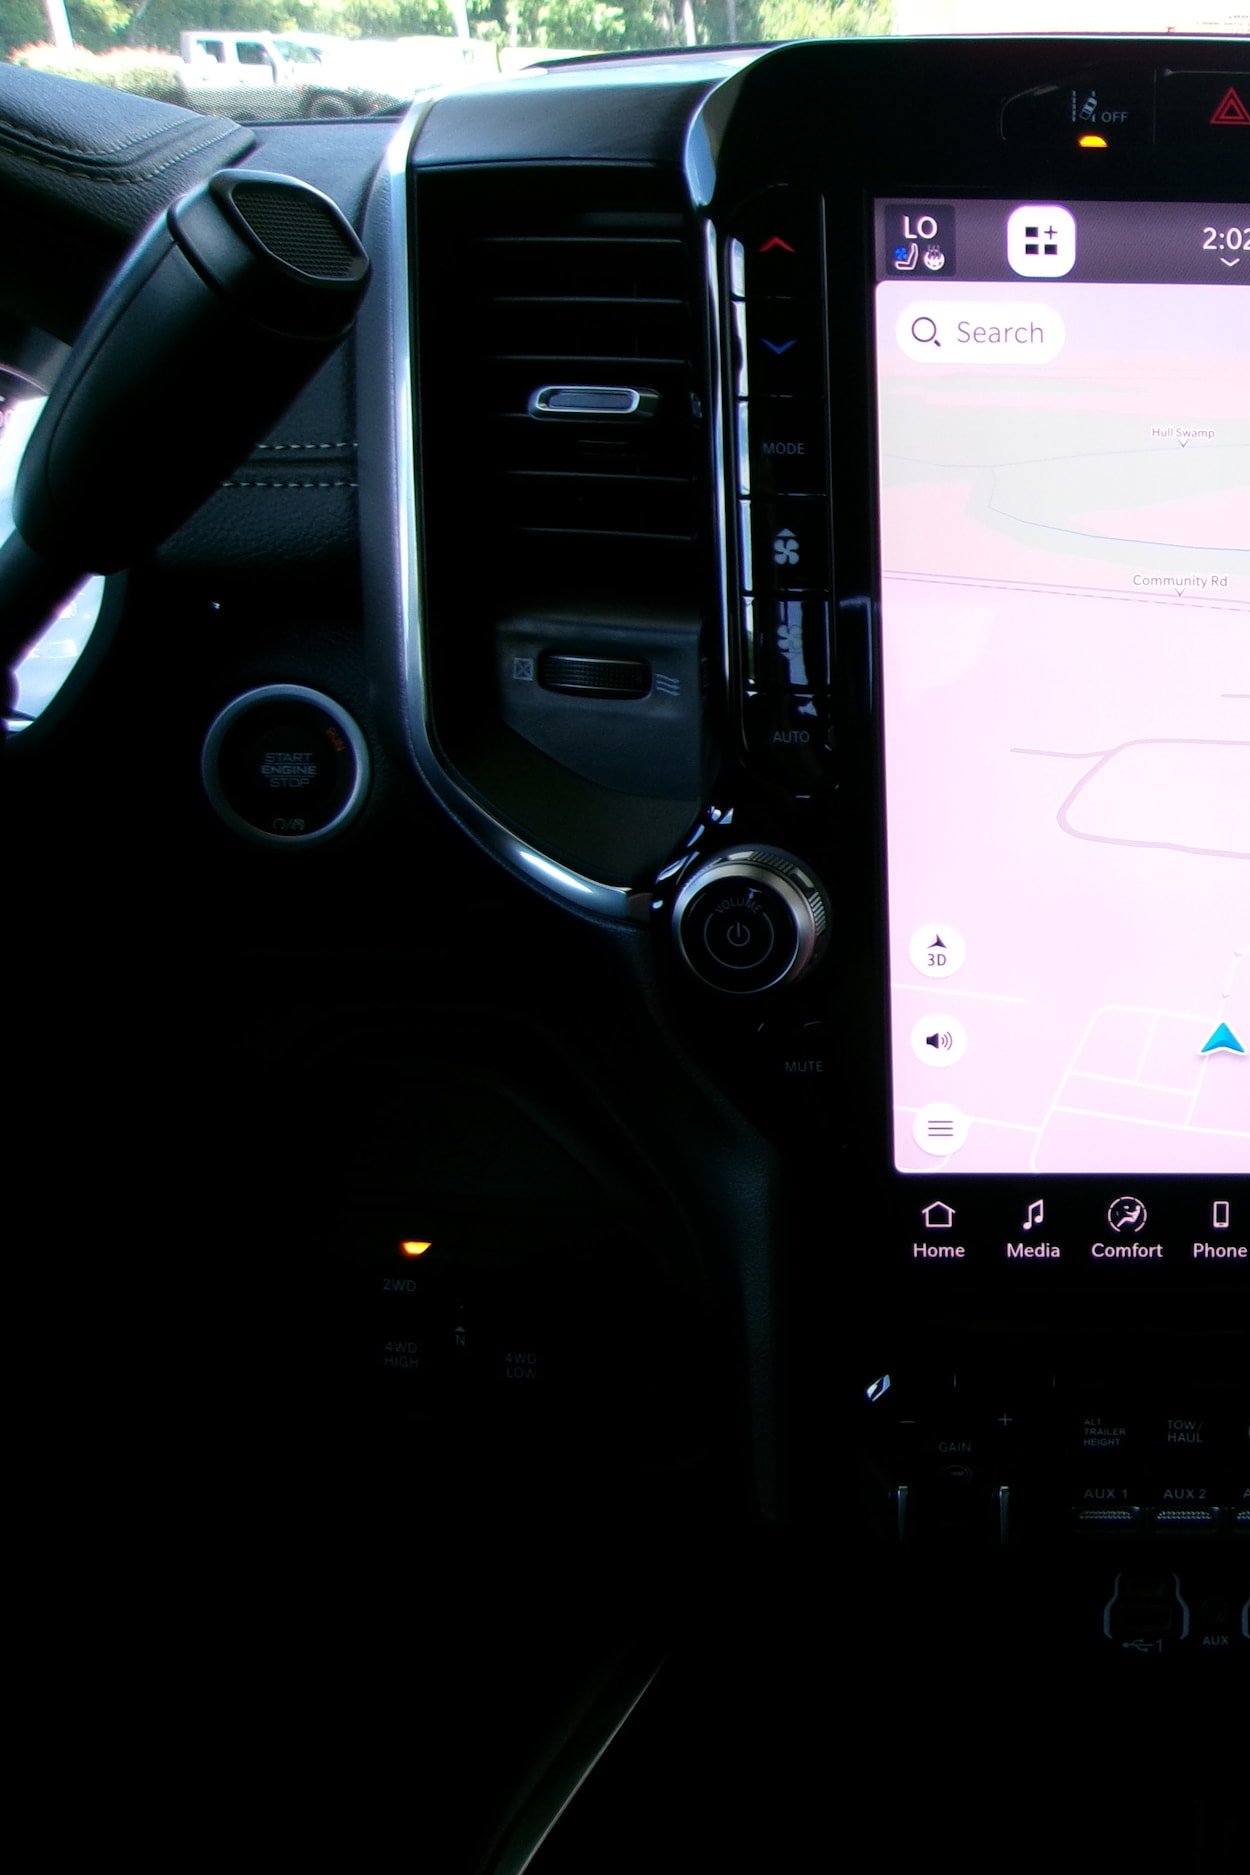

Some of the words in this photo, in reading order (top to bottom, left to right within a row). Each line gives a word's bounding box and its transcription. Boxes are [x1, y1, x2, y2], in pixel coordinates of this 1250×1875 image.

[1101, 111, 1128, 123] OFF
[903, 214, 938, 239] LO
[956, 321, 1044, 345] Search
[1151, 427, 1174, 437] Hull
[1176, 427, 1216, 440] Swamp
[761, 442, 806, 456] MODE
[1132, 574, 1208, 590] Community
[1211, 575, 1229, 588] Rd
[772, 729, 811, 744] AUTO
[264, 752, 313, 763] START
[260, 764, 318, 776] ENGINE
[269, 777, 311, 788] STOP
[714, 897, 764, 914] VOLUME
[927, 953, 947, 967] 3D
[784, 1060, 825, 1073] MUTE
[912, 1242, 966, 1258] Home
[1006, 1242, 1061, 1258] Media
[1091, 1242, 1164, 1258] Comfort
[1193, 1242, 1248, 1259] Phone
[383, 1277, 417, 1293] 2WD
[384, 1341, 418, 1354] 4WD
[383, 1356, 419, 1369] HIGH
[503, 1352, 537, 1365] 4WD
[506, 1366, 537, 1379] LOW
[1083, 1427, 1127, 1436] TRAILER
[1167, 1432, 1204, 1443] HAUL
[938, 1441, 972, 1453] GAIN
[1083, 1438, 1121, 1447] HEIGHT
[1083, 1488, 1119, 1500] AUX
[1122, 1488, 1128, 1500] 1
[1163, 1488, 1196, 1500] AUX
[1198, 1488, 1207, 1500] 2
[1155, 1639, 1163, 1653] 1
[1201, 1635, 1230, 1646] AUX
